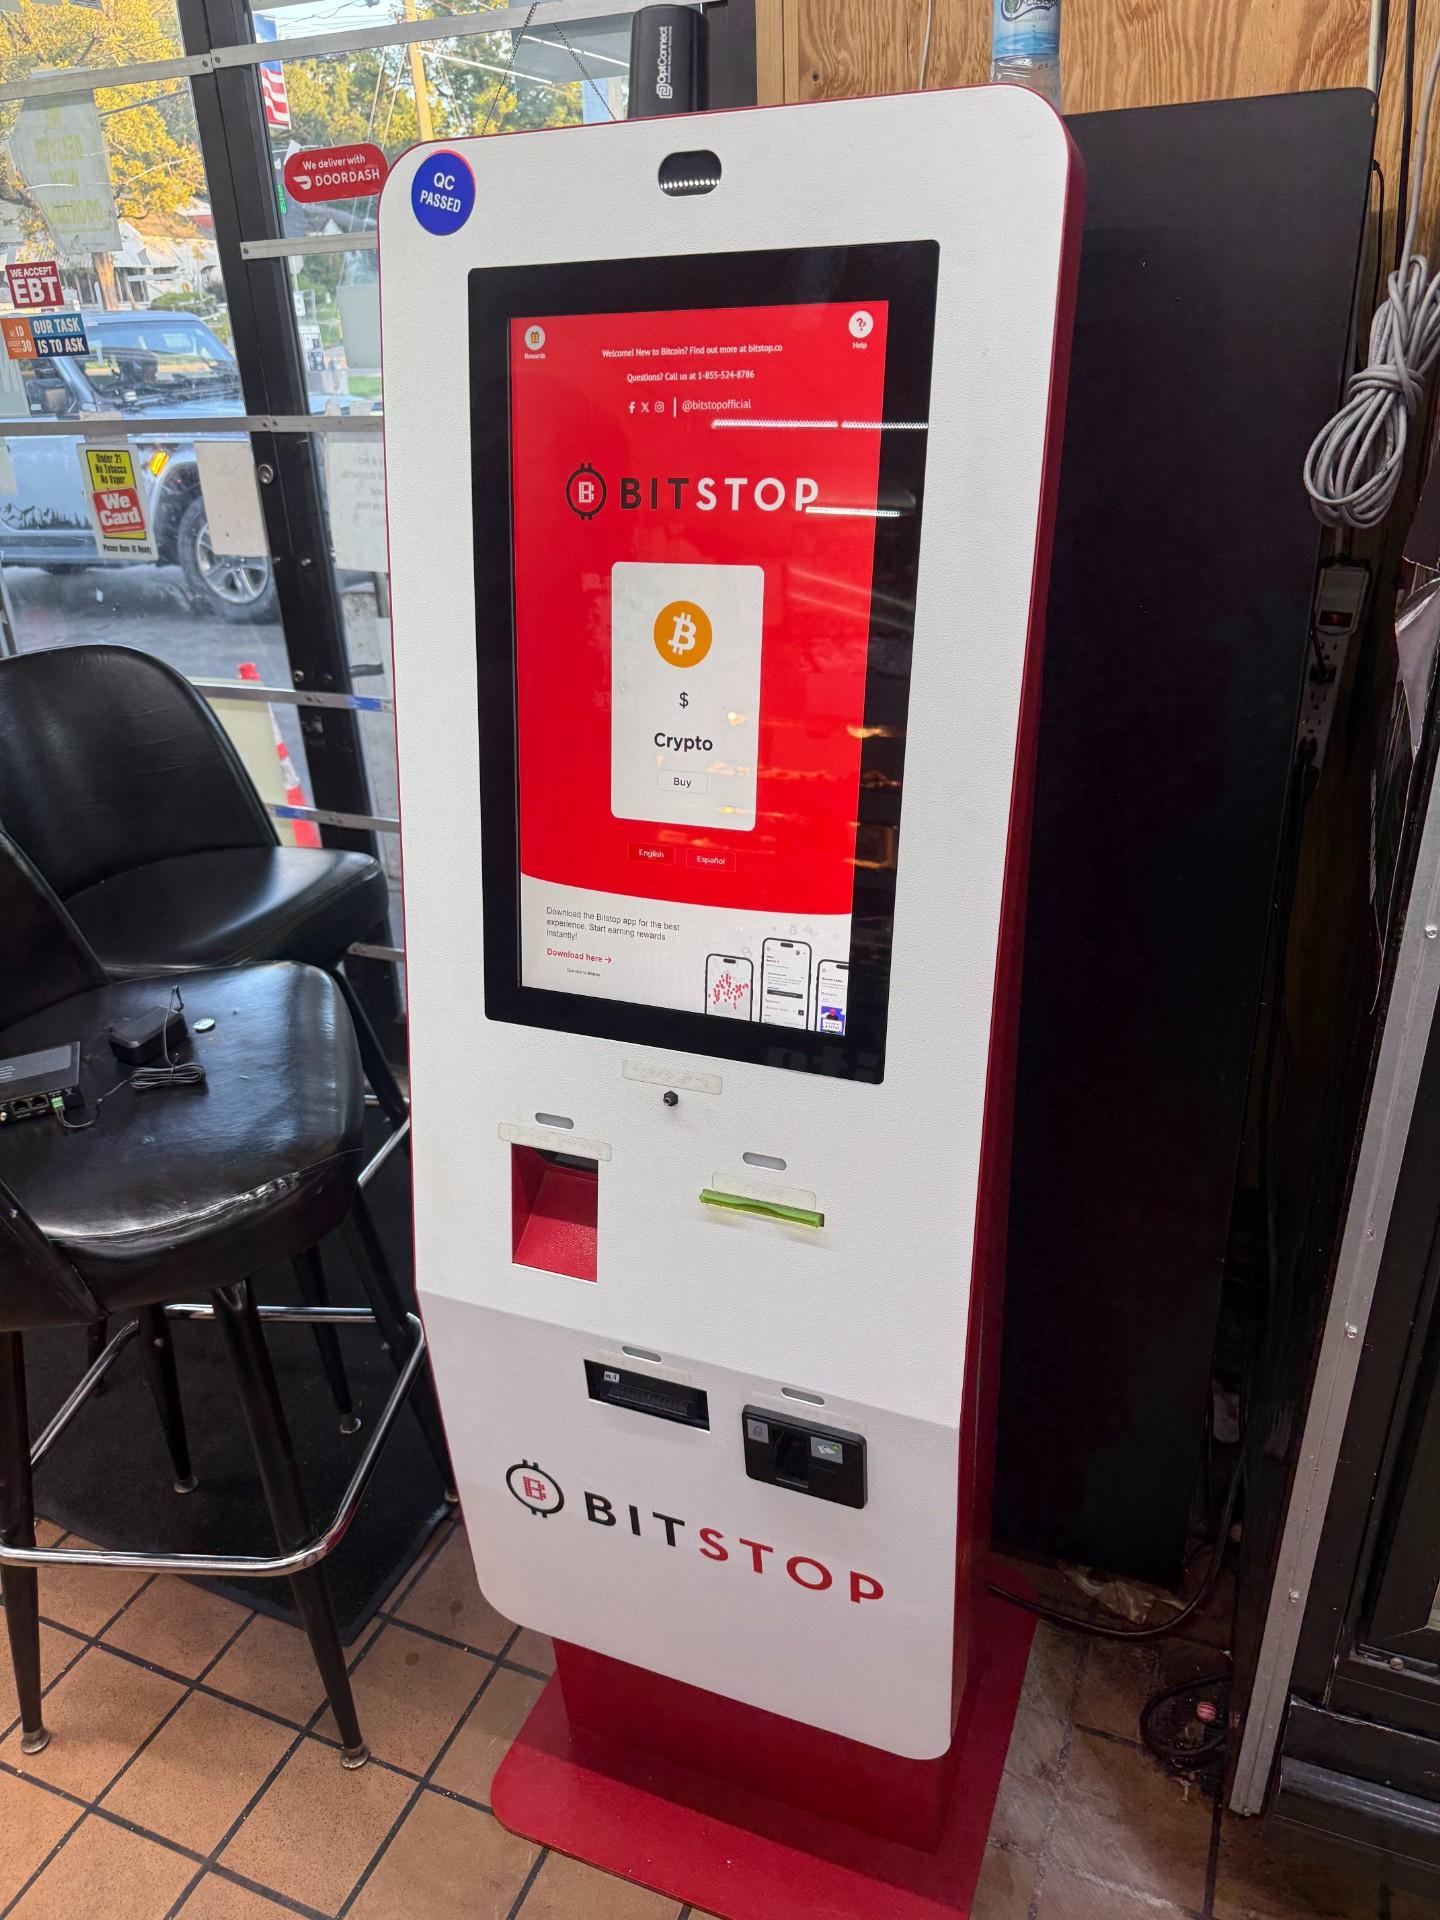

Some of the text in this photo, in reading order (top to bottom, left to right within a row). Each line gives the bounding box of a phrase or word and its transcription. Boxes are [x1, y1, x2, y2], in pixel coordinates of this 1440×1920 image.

[657, 26, 668, 84] OptConnect
[302, 154, 365, 171] We deliver with
[315, 168, 380, 187] DOORDASH
[433, 172, 456, 191] QC
[420, 190, 461, 213] PASSED
[10, 266, 53, 278] WE ACCEPT
[12, 276, 58, 304] EBT
[15, 325, 25, 337] ID
[33, 319, 54, 334] OUR
[54, 317, 81, 333] TASK
[21, 340, 32, 353] 30
[37, 339, 48, 354] IS
[49, 338, 62, 353] TO
[64, 337, 86, 353] ASK
[602, 344, 783, 358] Welcome! New to Bitcoin? Find out more at bitstop.co
[852, 341, 868, 350] Help
[626, 373, 664, 383] Questions?
[664, 372, 678, 381] Call
[679, 373, 688, 381] us
[697, 370, 755, 380] 1-855-524-8786
[682, 398, 752, 413] @bitstopofficial
[96, 453, 122, 464] Under 21
[95, 463, 103, 474] No
[100, 474, 109, 484] No
[101, 492, 131, 510] We
[620, 477, 819, 512] BITSTOP
[99, 507, 141, 526] Card
[679, 691, 689, 708] $
[653, 732, 713, 752] Crypto
[673, 777, 692, 788] Buy
[638, 848, 665, 859] English
[696, 855, 726, 866] Español
[546, 906, 680, 931] Download the Bitstop app for the best
[546, 919, 666, 941] experience. Start earning rewards
[546, 929, 578, 941] instantly!
[547, 948, 603, 963] Download here
[584, 1491, 884, 1604] BITSTOP
